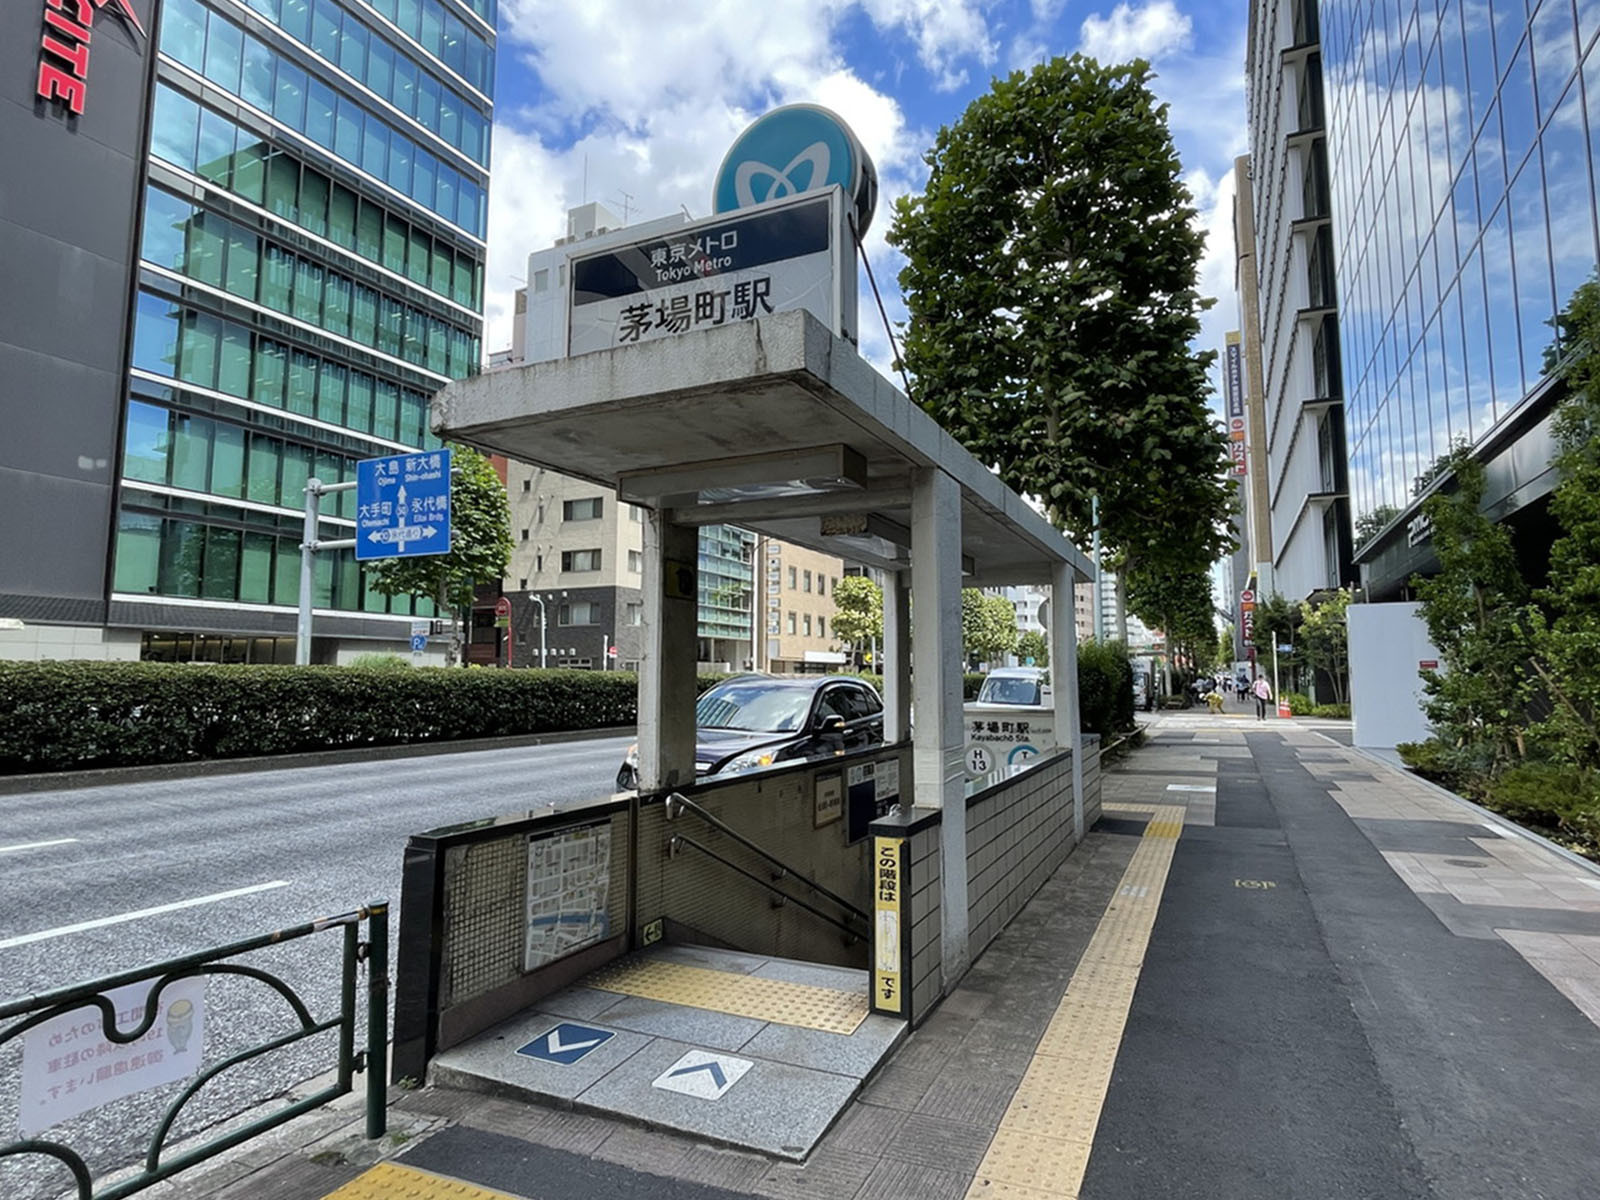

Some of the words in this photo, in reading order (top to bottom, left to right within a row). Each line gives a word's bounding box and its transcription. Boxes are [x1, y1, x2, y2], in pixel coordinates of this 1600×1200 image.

[650, 230, 738, 269] 東京メトロ
[655, 264, 691, 282] Tokyo
[693, 255, 732, 274] Metro
[619, 276, 775, 342] 茅場町駅
[359, 501, 392, 518] 大手町
[411, 495, 447, 512] 永代橋
[972, 721, 1030, 734] 茅場町駅
[974, 750, 983, 759] H
[972, 761, 987, 771] 13
[879, 846, 896, 902] この階段は
[881, 976, 896, 999] です
